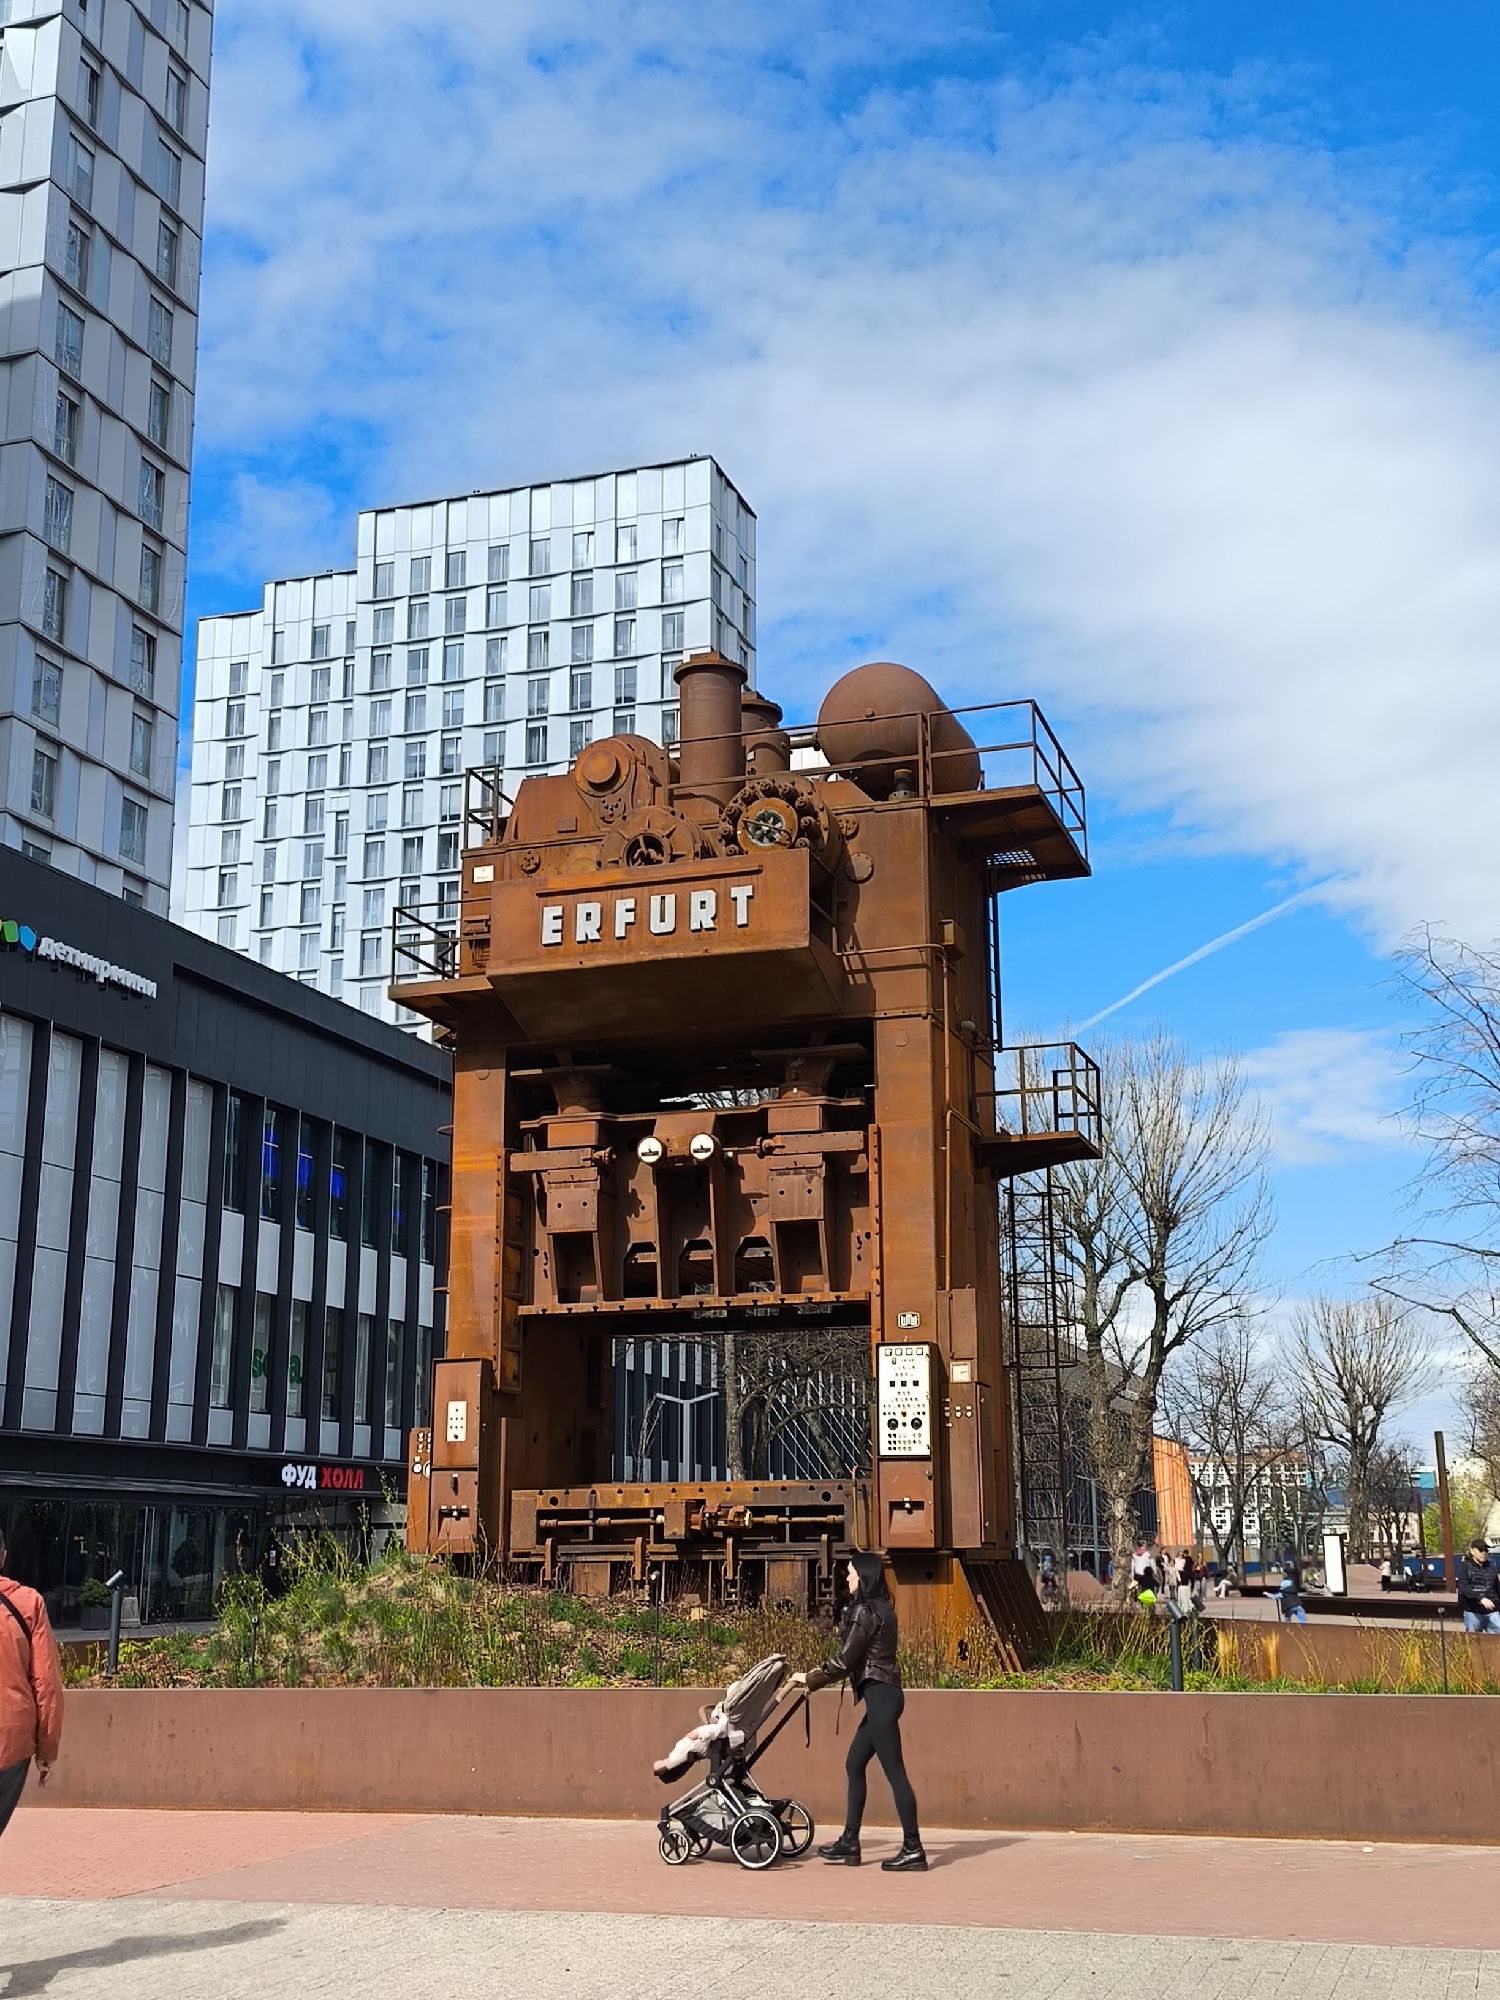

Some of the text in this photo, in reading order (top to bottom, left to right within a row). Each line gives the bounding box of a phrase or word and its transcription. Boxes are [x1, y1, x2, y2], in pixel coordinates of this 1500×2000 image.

[542, 884, 753, 947] ERFURT
[281, 1463, 364, 1490] ФУД ХОЛЛ
